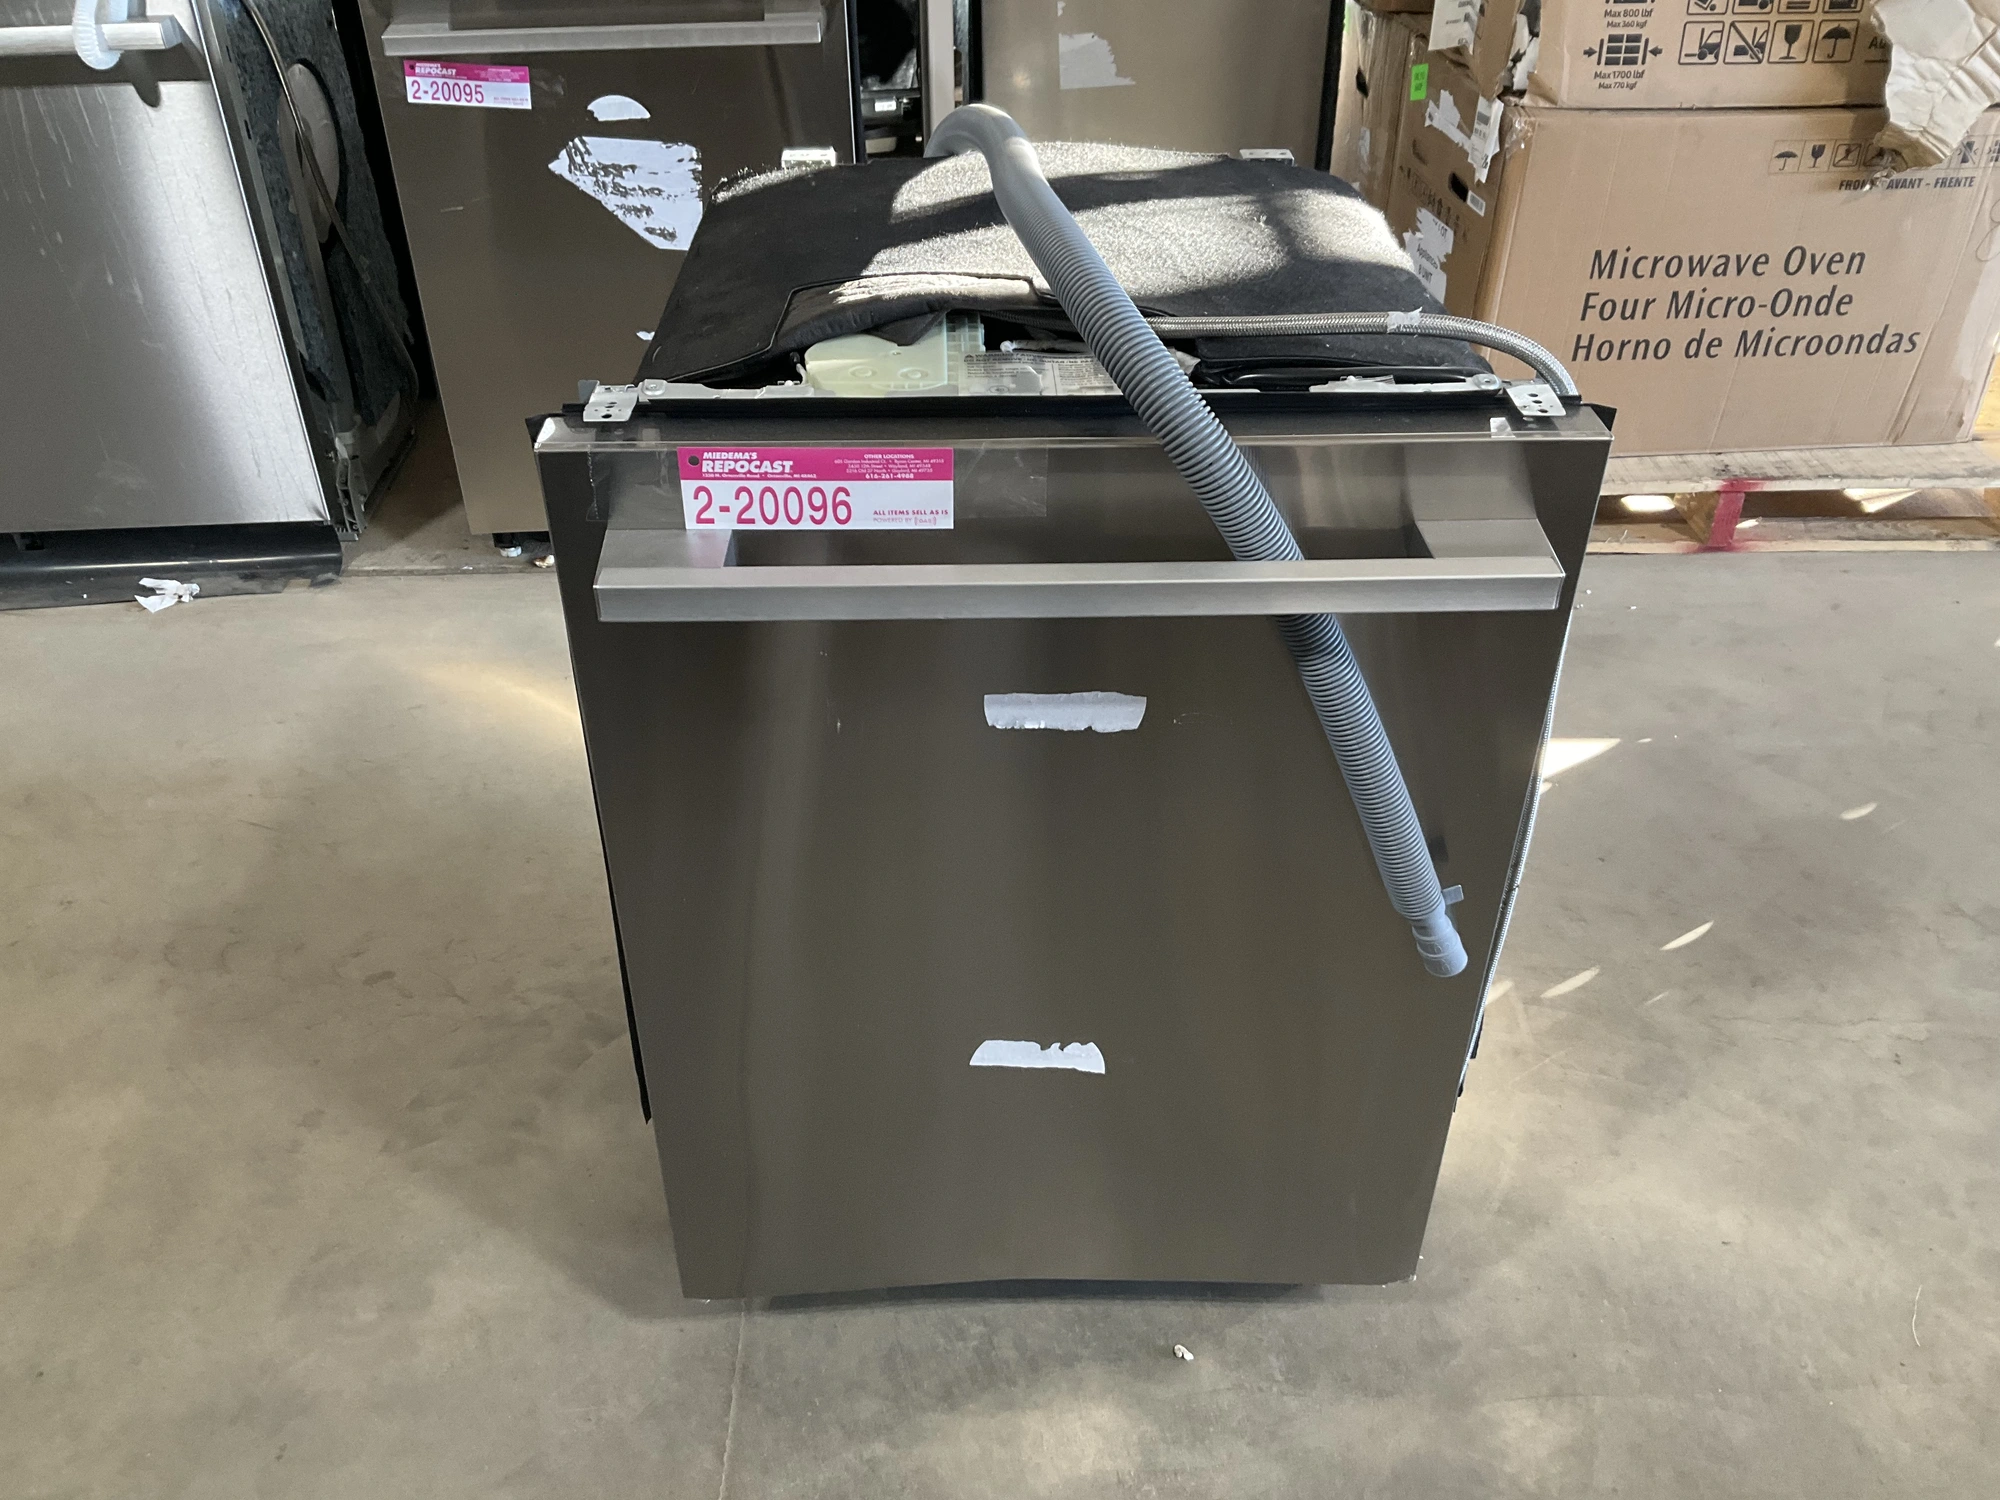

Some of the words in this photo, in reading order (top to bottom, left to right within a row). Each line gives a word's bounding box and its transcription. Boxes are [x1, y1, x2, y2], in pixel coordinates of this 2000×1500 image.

[1604, 9, 1621, 18] Max
[1622, 9, 1640, 17] 800
[1641, 8, 1654, 17] lbf
[1636, 20, 1648, 29] kgf
[1594, 71, 1611, 79] Max
[1612, 70, 1632, 79] 1700
[1633, 69, 1645, 79] lbf
[411, 80, 485, 104] 2-20095
[1626, 81, 1638, 90] kgf
[1886, 178, 1924, 190] AVANT
[1934, 176, 1976, 189] FRENTE
[1589, 246, 1770, 280] Microwave
[1783, 245, 1866, 276] Oven
[1579, 291, 1657, 322] Four
[1665, 284, 1854, 320] Micro-Onde
[1571, 333, 1672, 362] Horno
[1684, 328, 1723, 360] de
[1734, 324, 1921, 358] Microondas
[703, 452, 757, 460] MIEDEMA'S
[702, 460, 793, 473] REPOCAST
[693, 485, 852, 525] 2-20096
